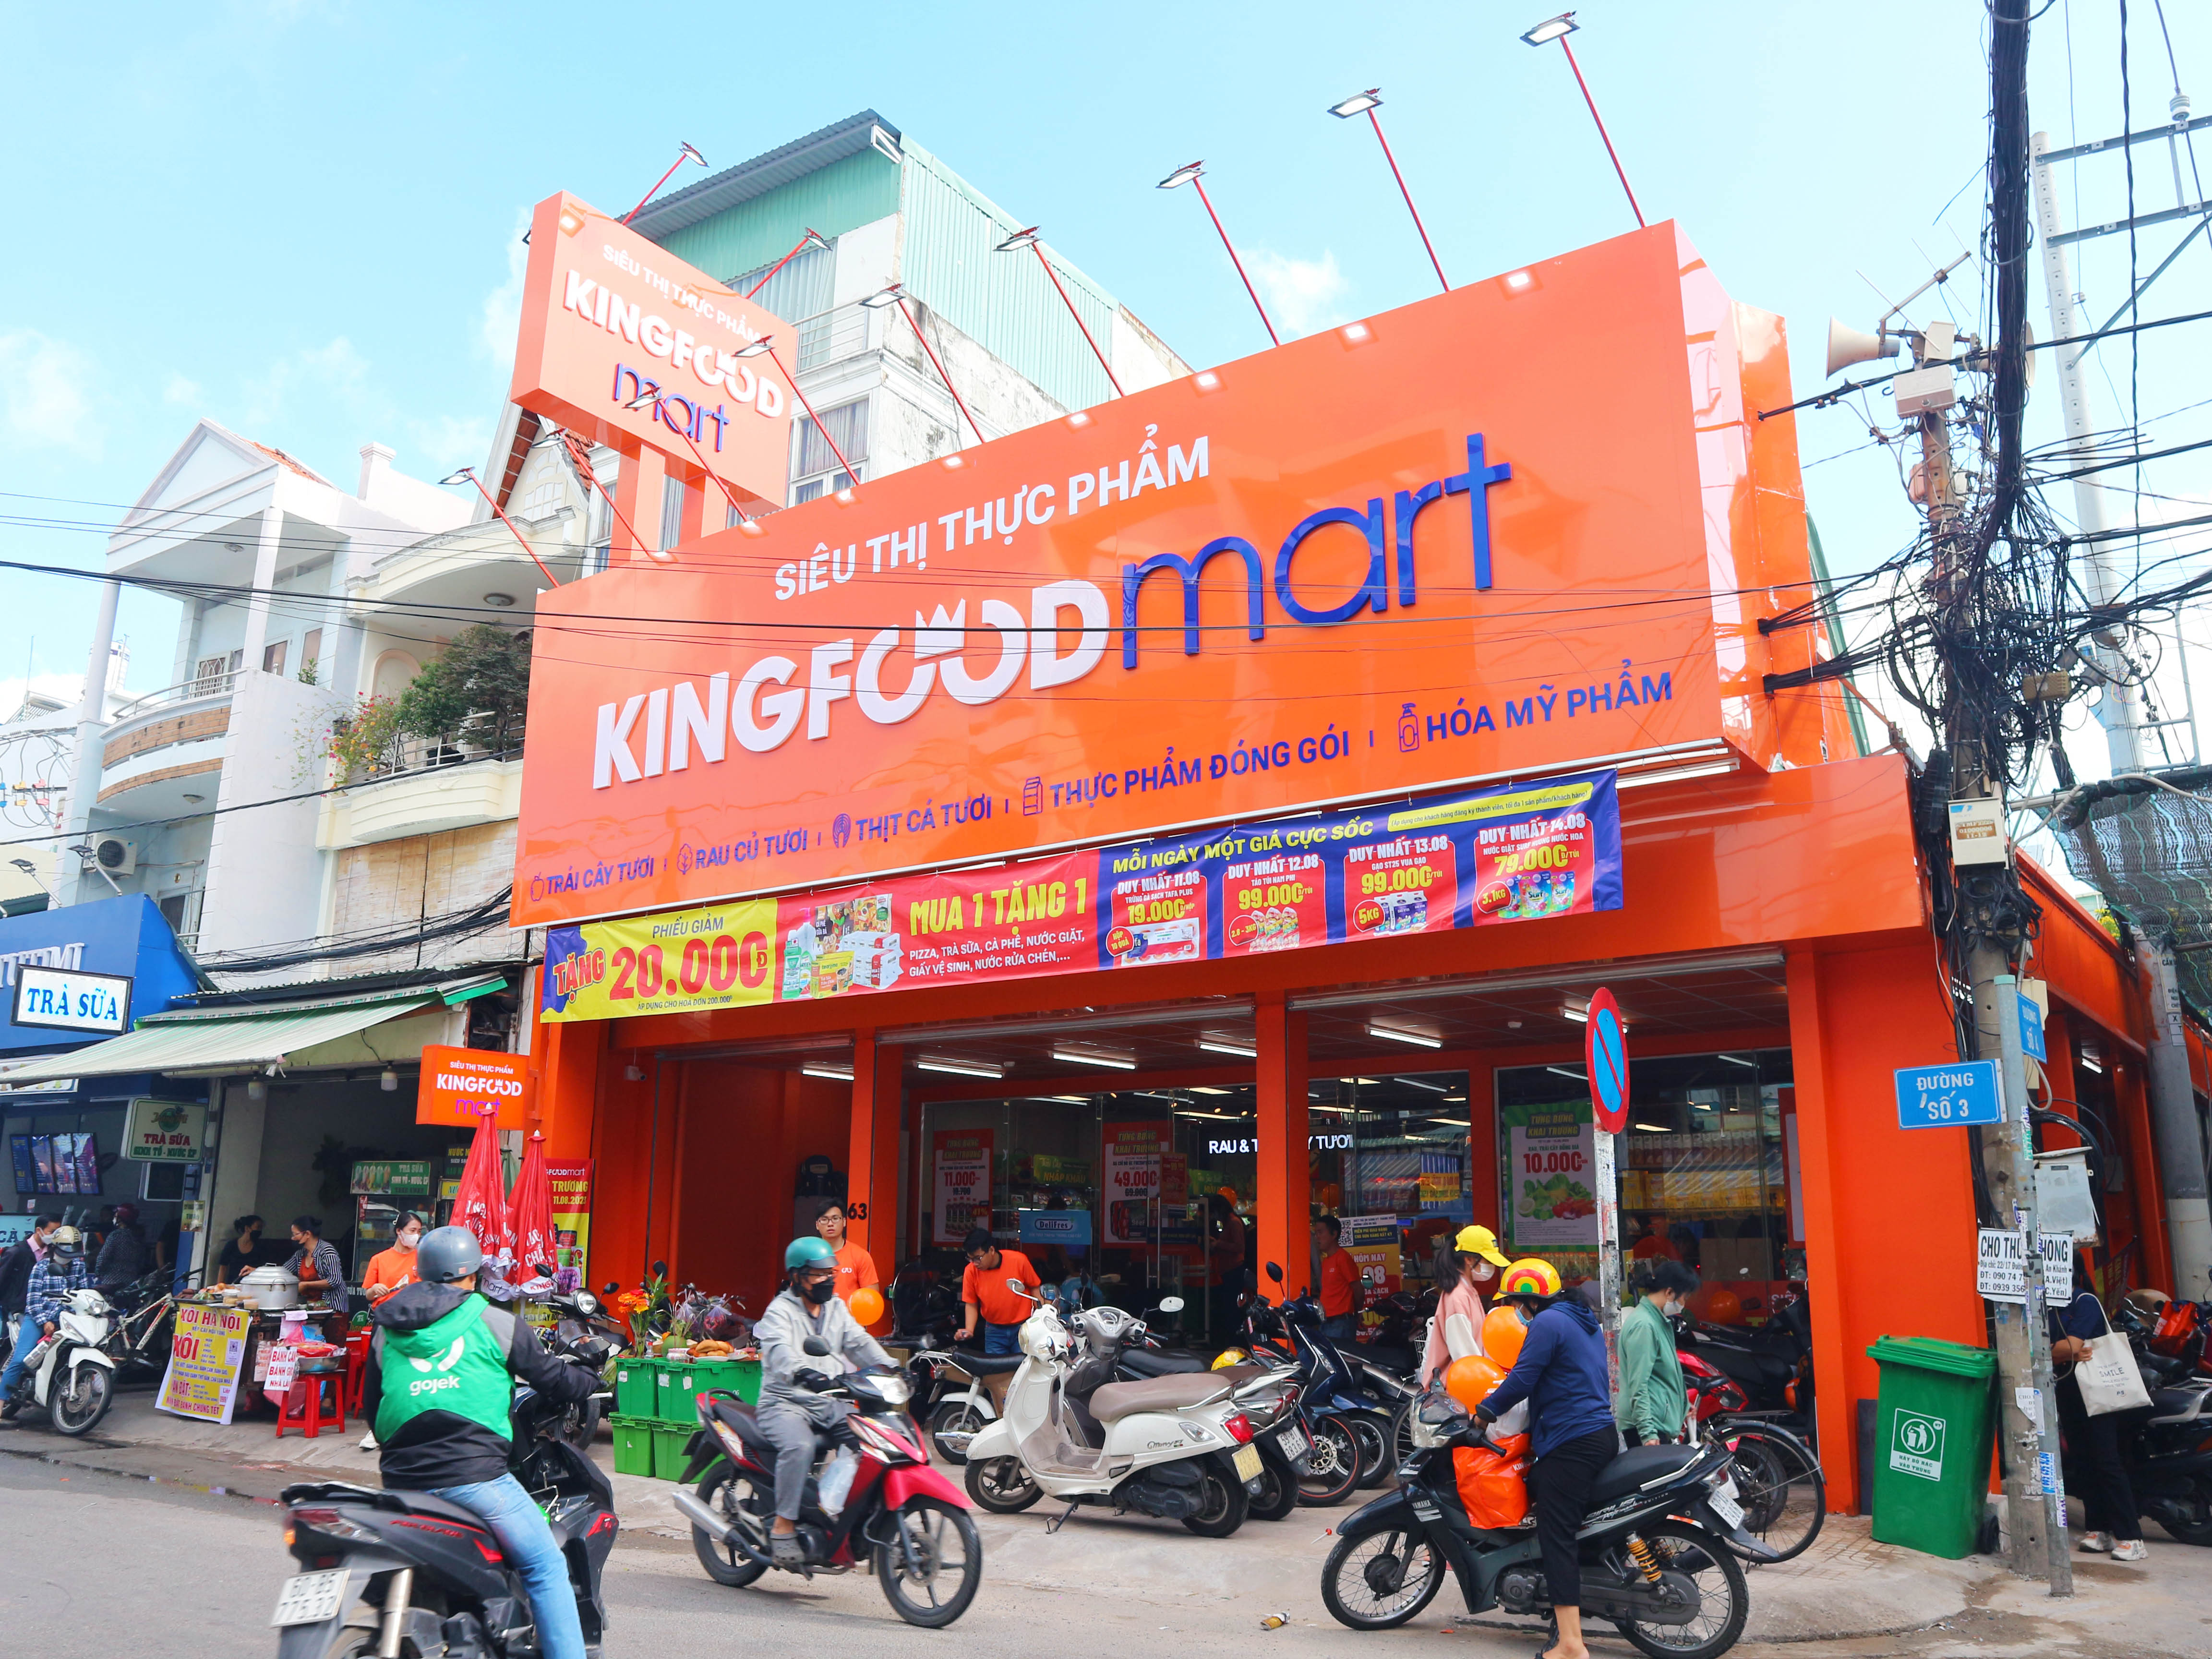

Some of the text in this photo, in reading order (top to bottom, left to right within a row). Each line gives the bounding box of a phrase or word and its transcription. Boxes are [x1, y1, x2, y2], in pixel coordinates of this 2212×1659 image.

[603, 244, 639, 277] SIÊU
[643, 266, 669, 299] THỊ
[672, 285, 713, 319] THỰC
[563, 269, 784, 418] KINGFOOD
[613, 363, 730, 452] mart
[775, 423, 1209, 600] SIÊU THỊ THỰC PHẨM
[593, 430, 1512, 790] KINGFOOD mart
[546, 659, 1672, 894] TRÁI CÂY TƯƠI RAU CỦ TƯƠI THỊT CÁ TƯƠI THỰC PHẨM ĐÓNG GÓI HÓA MỸ PHẨM
[1479, 813, 1586, 845] DUY NHẤT 14.08
[1570, 832, 1584, 841] HOA
[1113, 816, 1373, 874] MỖI NGÀY MỘT GIÁ CỰC SỐC
[1349, 835, 1448, 863] DUY NHẤT 13.08
[1228, 854, 1319, 879] DUY NHẤT 12.08
[1384, 860, 1399, 869] ST25
[1401, 858, 1413, 866] VUA
[1118, 871, 1200, 895] DUY NHẤT 11.08
[1165, 890, 1178, 898] TAFA
[1179, 888, 1193, 896] PLUS
[910, 878, 1087, 936] MUA 1 TẶNG 1
[1482, 889, 1506, 905] 3.1KG
[653, 914, 724, 938] PHIẾU GIẢM
[1358, 907, 1380, 925] 5KG
[910, 927, 1085, 961] PIZZA, TRÀ SỮA, CÀ PHÊ, NƯỚC GIẶT,
[1112, 930, 1124, 940] HỘP
[553, 947, 605, 1004] TẶNG
[910, 962, 931, 977] GIẤY
[932, 960, 945, 977] VỆ
[947, 958, 973, 974] SINH,
[975, 953, 1003, 971] NƯỚC
[1005, 950, 1025, 967] RỬA
[27, 984, 118, 1021] TRÀ SỮA
[646, 1000, 663, 1011] DỤNG
[664, 998, 677, 1009] CHO
[450, 1060, 514, 1075] SIÊU THỊ THỰC PHẨM
[437, 1073, 522, 1097] KINGFOOD
[1916, 1072, 1974, 1091] ĐƯỜNG
[1927, 1090, 1969, 1120] SỐ 3
[144, 1131, 190, 1146] TRÀ SỮA
[1209, 1139, 1250, 1154] RAU &
[552, 1179, 588, 1192] TRƯƠNG
[848, 1203, 868, 1220] 63
[1354, 1253, 1386, 1263] HÔM NAY
[1981, 1235, 2000, 1258] CHO
[1980, 1271, 1991, 1279] ĐT:
[1993, 1283, 2010, 1291] 0939
[180, 1306, 199, 1323] XÔI
[220, 1313, 241, 1333] NỘI
[173, 1332, 200, 1361] XÔI
[2099, 1367, 2125, 1378] SMILE
[409, 1375, 460, 1396] gojek
[1411, 1499, 1432, 1510] YAMAHA
